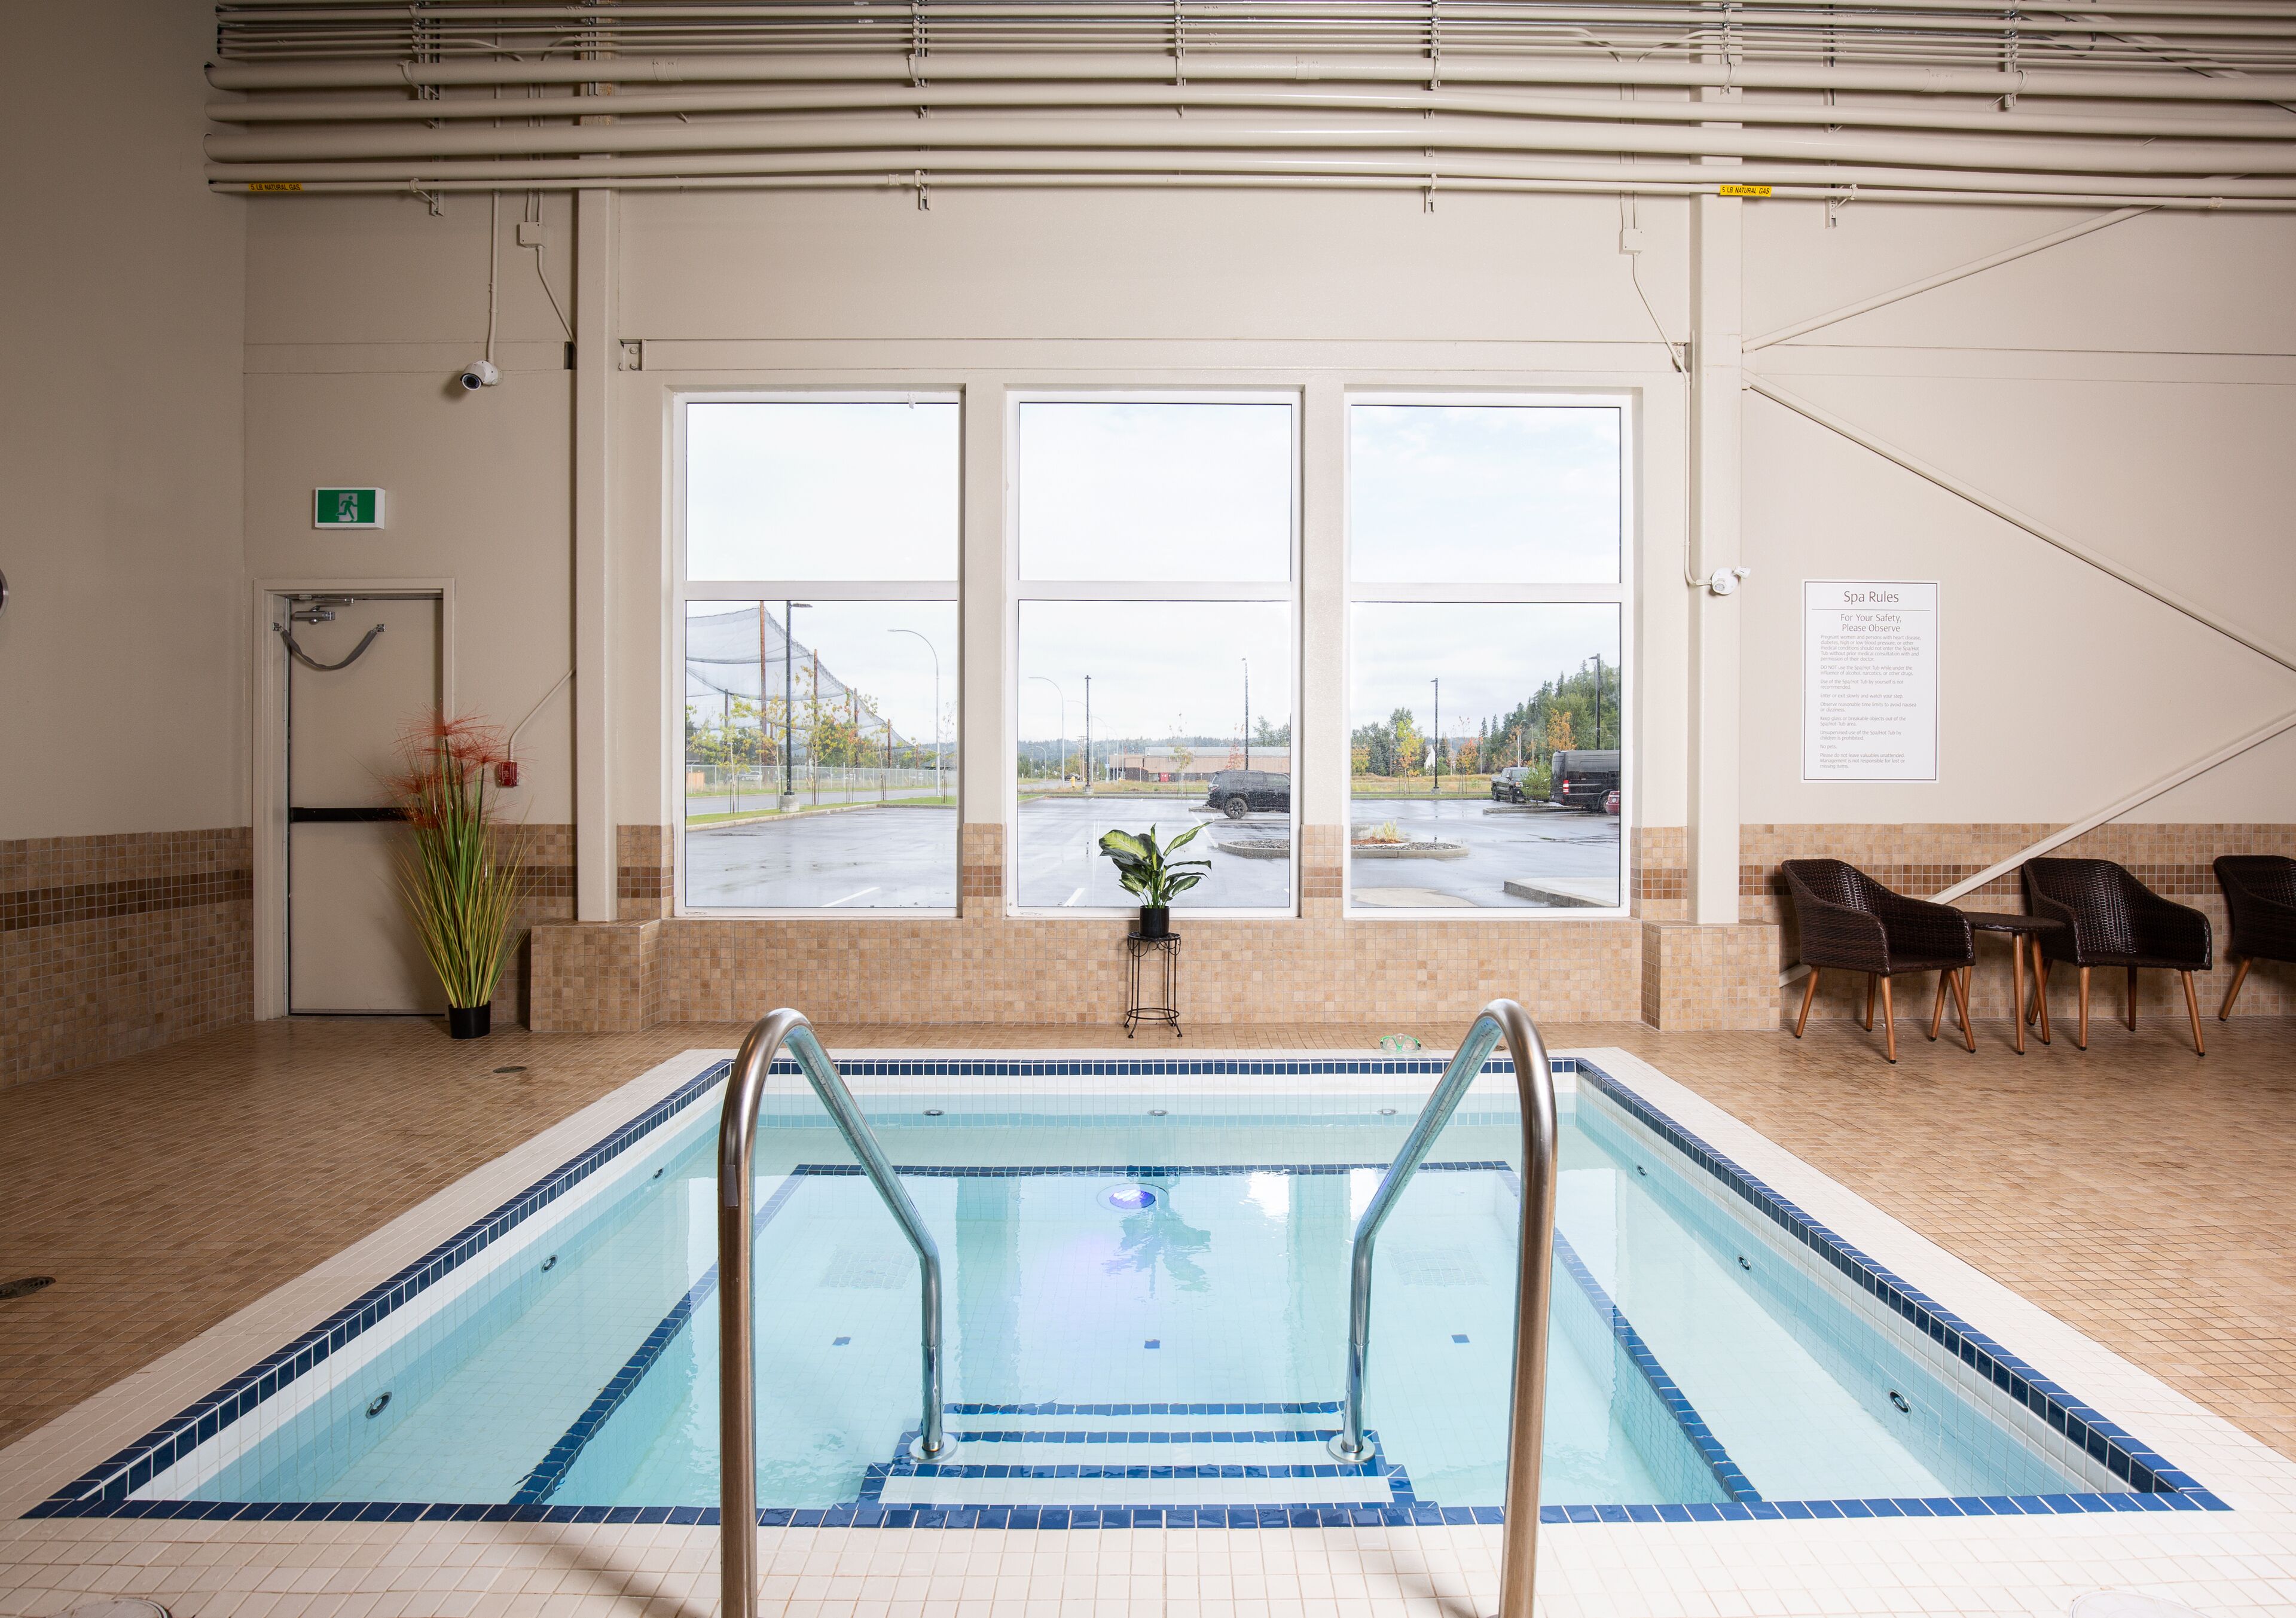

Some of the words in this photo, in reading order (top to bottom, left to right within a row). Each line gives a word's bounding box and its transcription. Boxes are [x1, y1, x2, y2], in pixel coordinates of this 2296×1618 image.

[1844, 591, 1865, 604] Spa
[1869, 591, 1899, 603] Rules
[1876, 614, 1902, 623] Safety,
